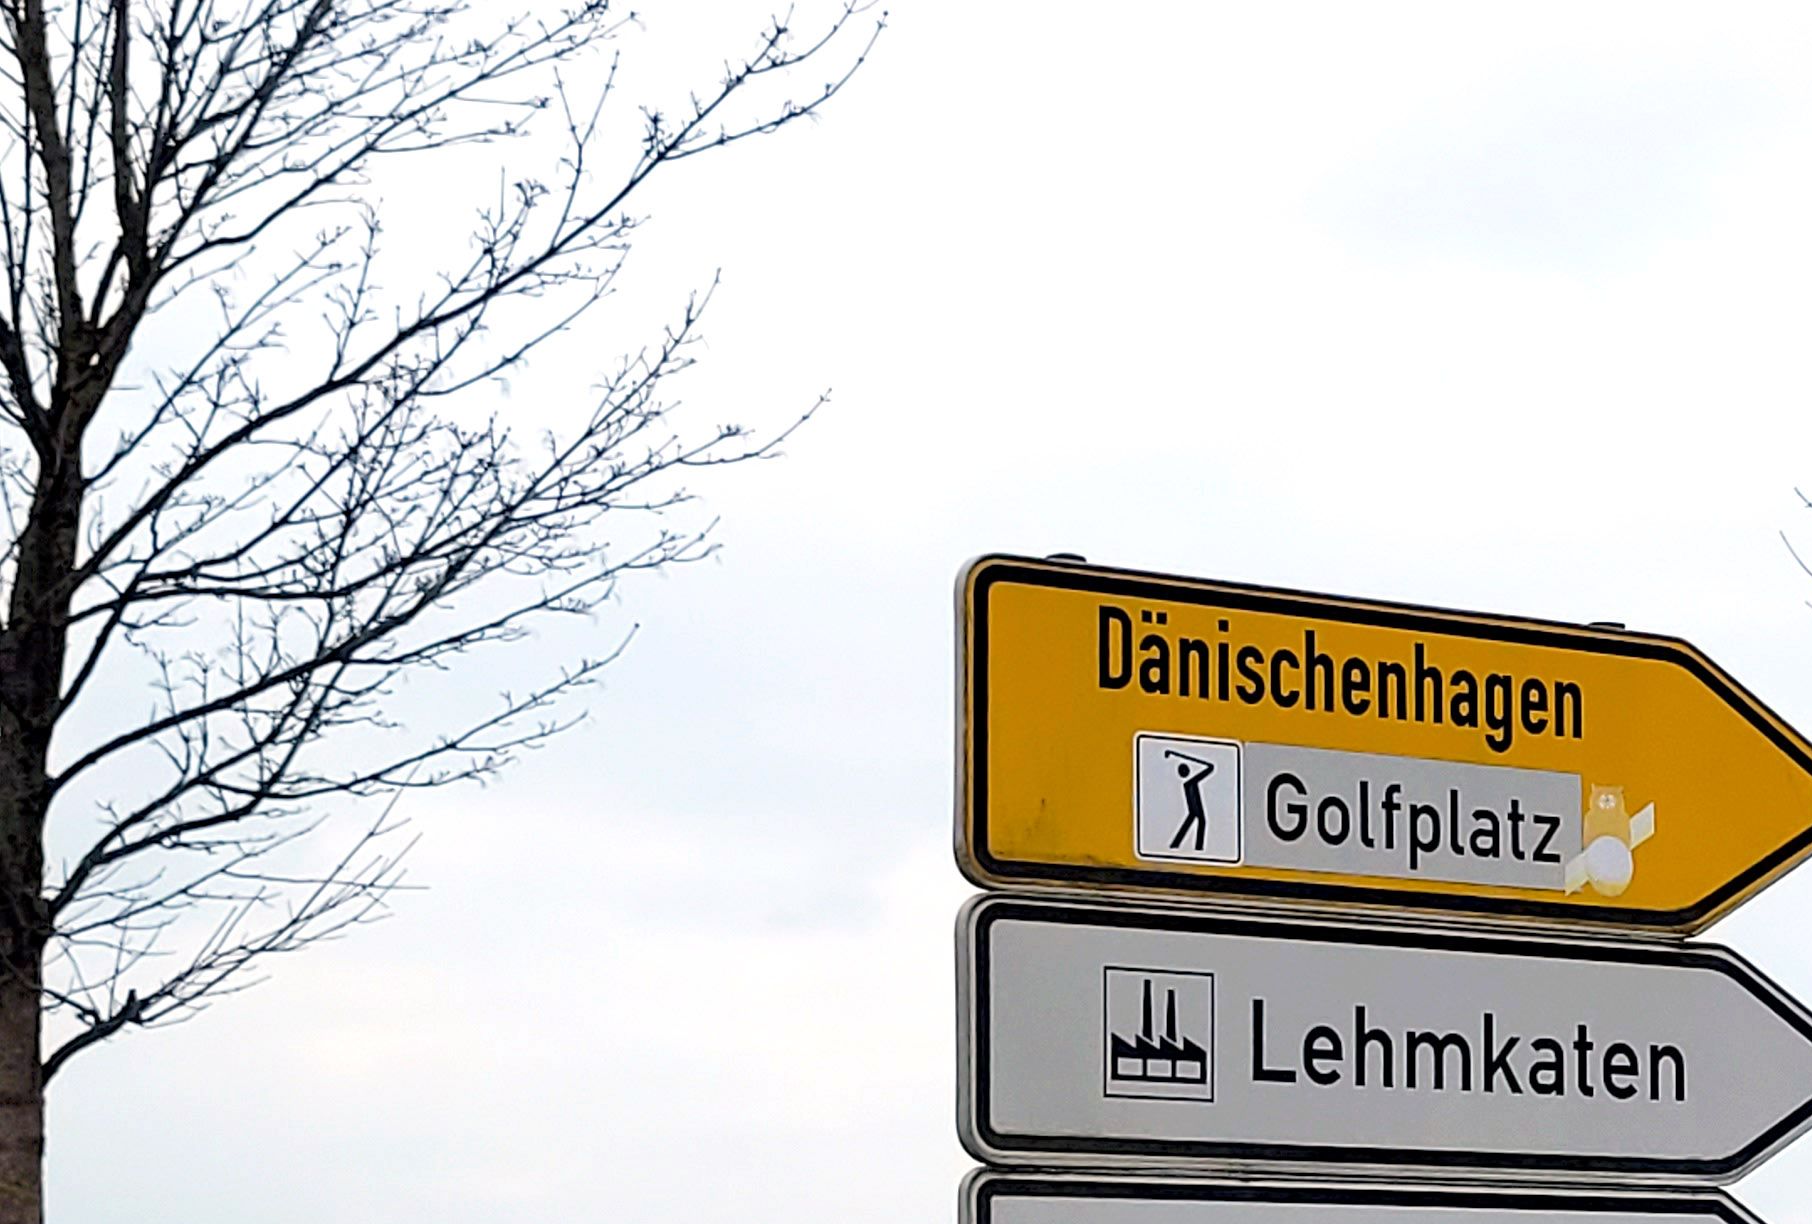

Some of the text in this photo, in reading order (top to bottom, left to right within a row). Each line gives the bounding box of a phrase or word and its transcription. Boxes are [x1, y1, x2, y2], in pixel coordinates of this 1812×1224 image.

[1099, 604, 1582, 754] Dänischenhagen
[1267, 772, 1562, 871] Golfplatz
[1252, 999, 1686, 1102] Lehmkaten
